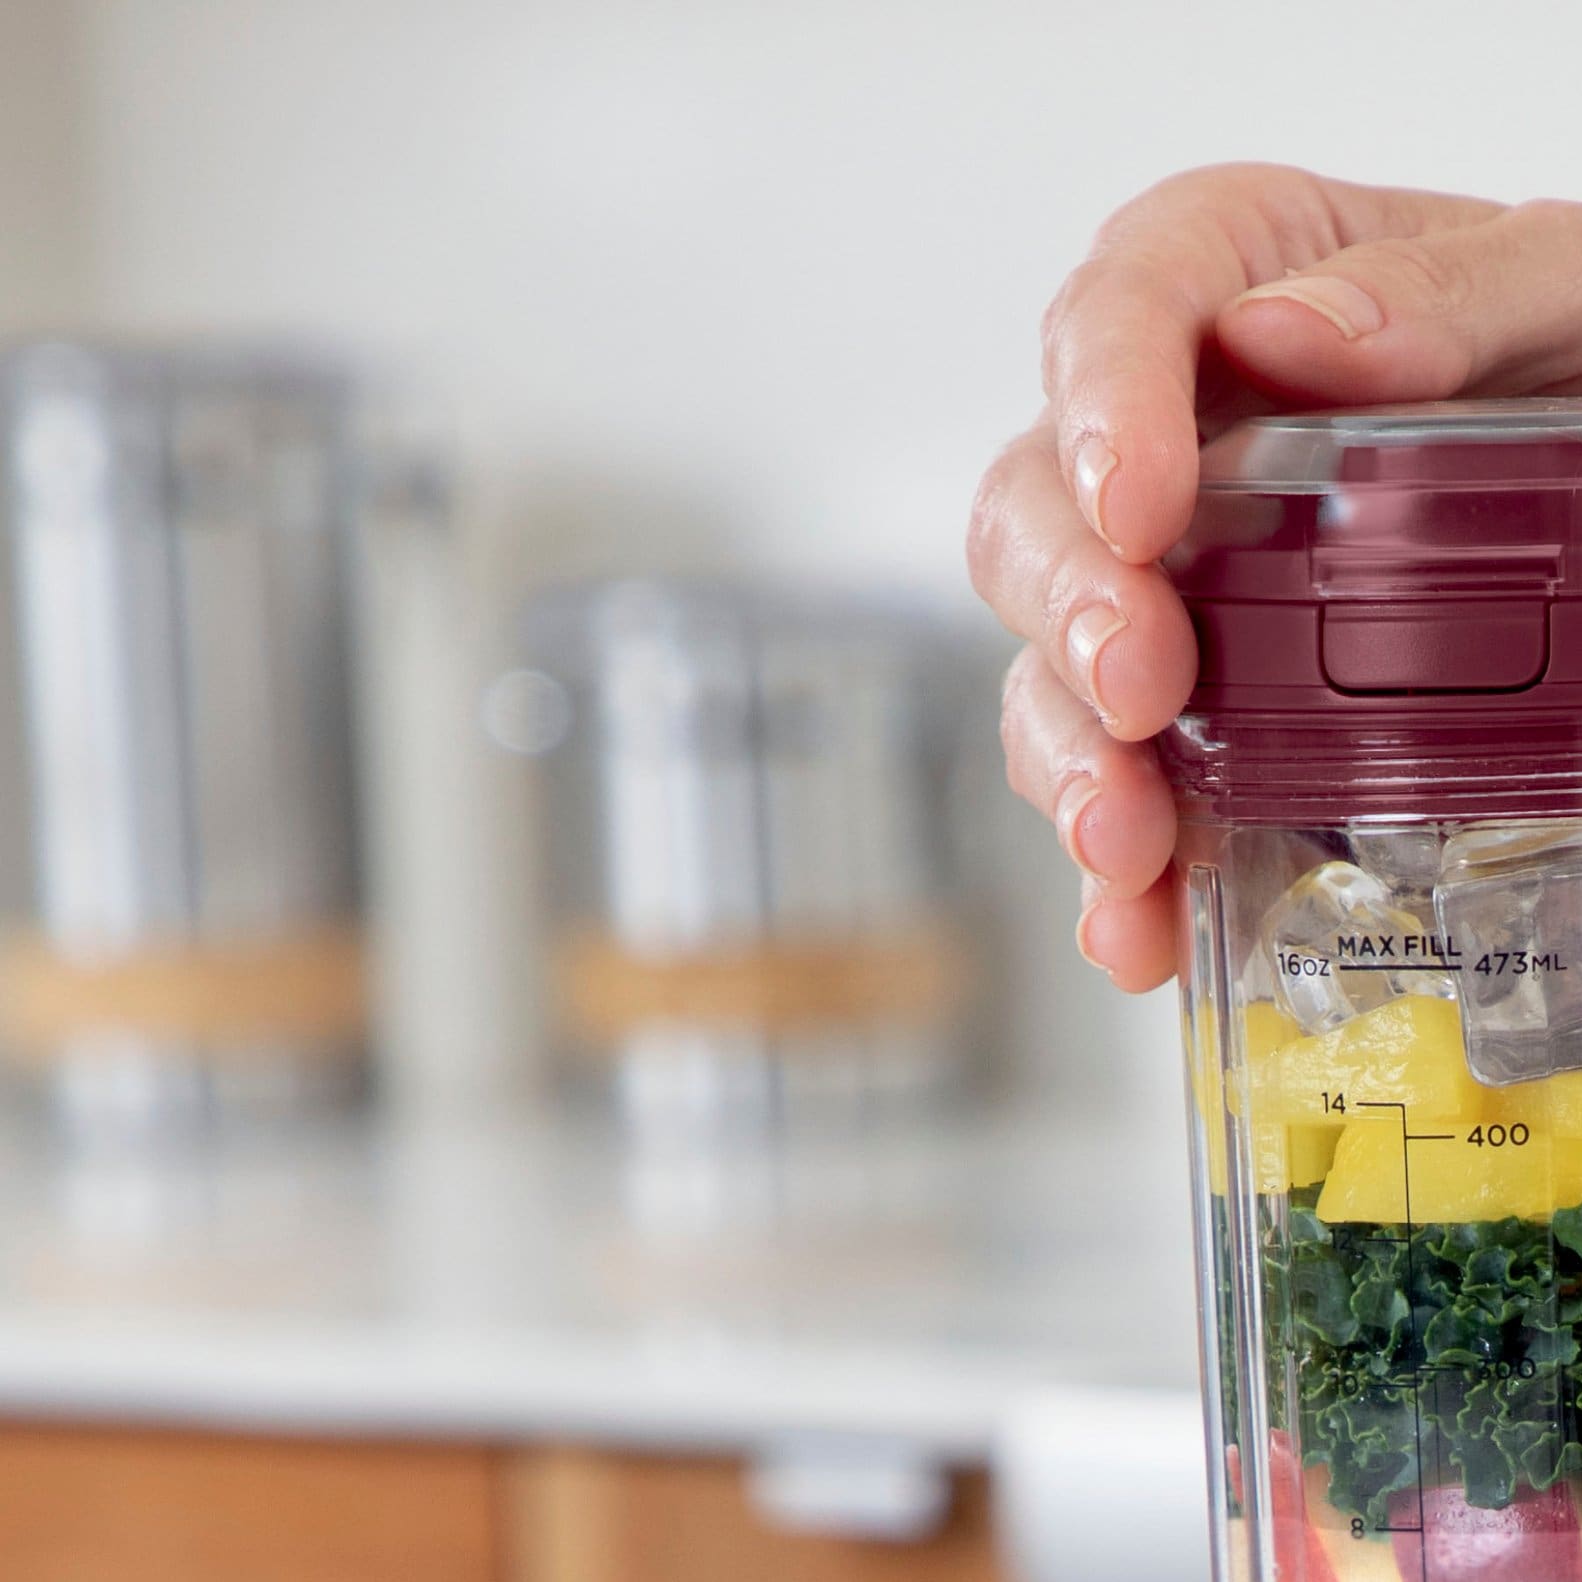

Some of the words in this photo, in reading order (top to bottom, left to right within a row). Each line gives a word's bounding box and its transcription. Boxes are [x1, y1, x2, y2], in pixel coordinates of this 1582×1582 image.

[1337, 936, 1395, 957] MAX
[1404, 935, 1463, 957] FILL
[1474, 951, 1568, 976] 473ML
[1321, 1092, 1347, 1115] 14
[1466, 1123, 1530, 1147] 400
[1479, 1357, 1536, 1380] 300
[1330, 1372, 1358, 1396] 10
[1351, 1518, 1365, 1540] 8
